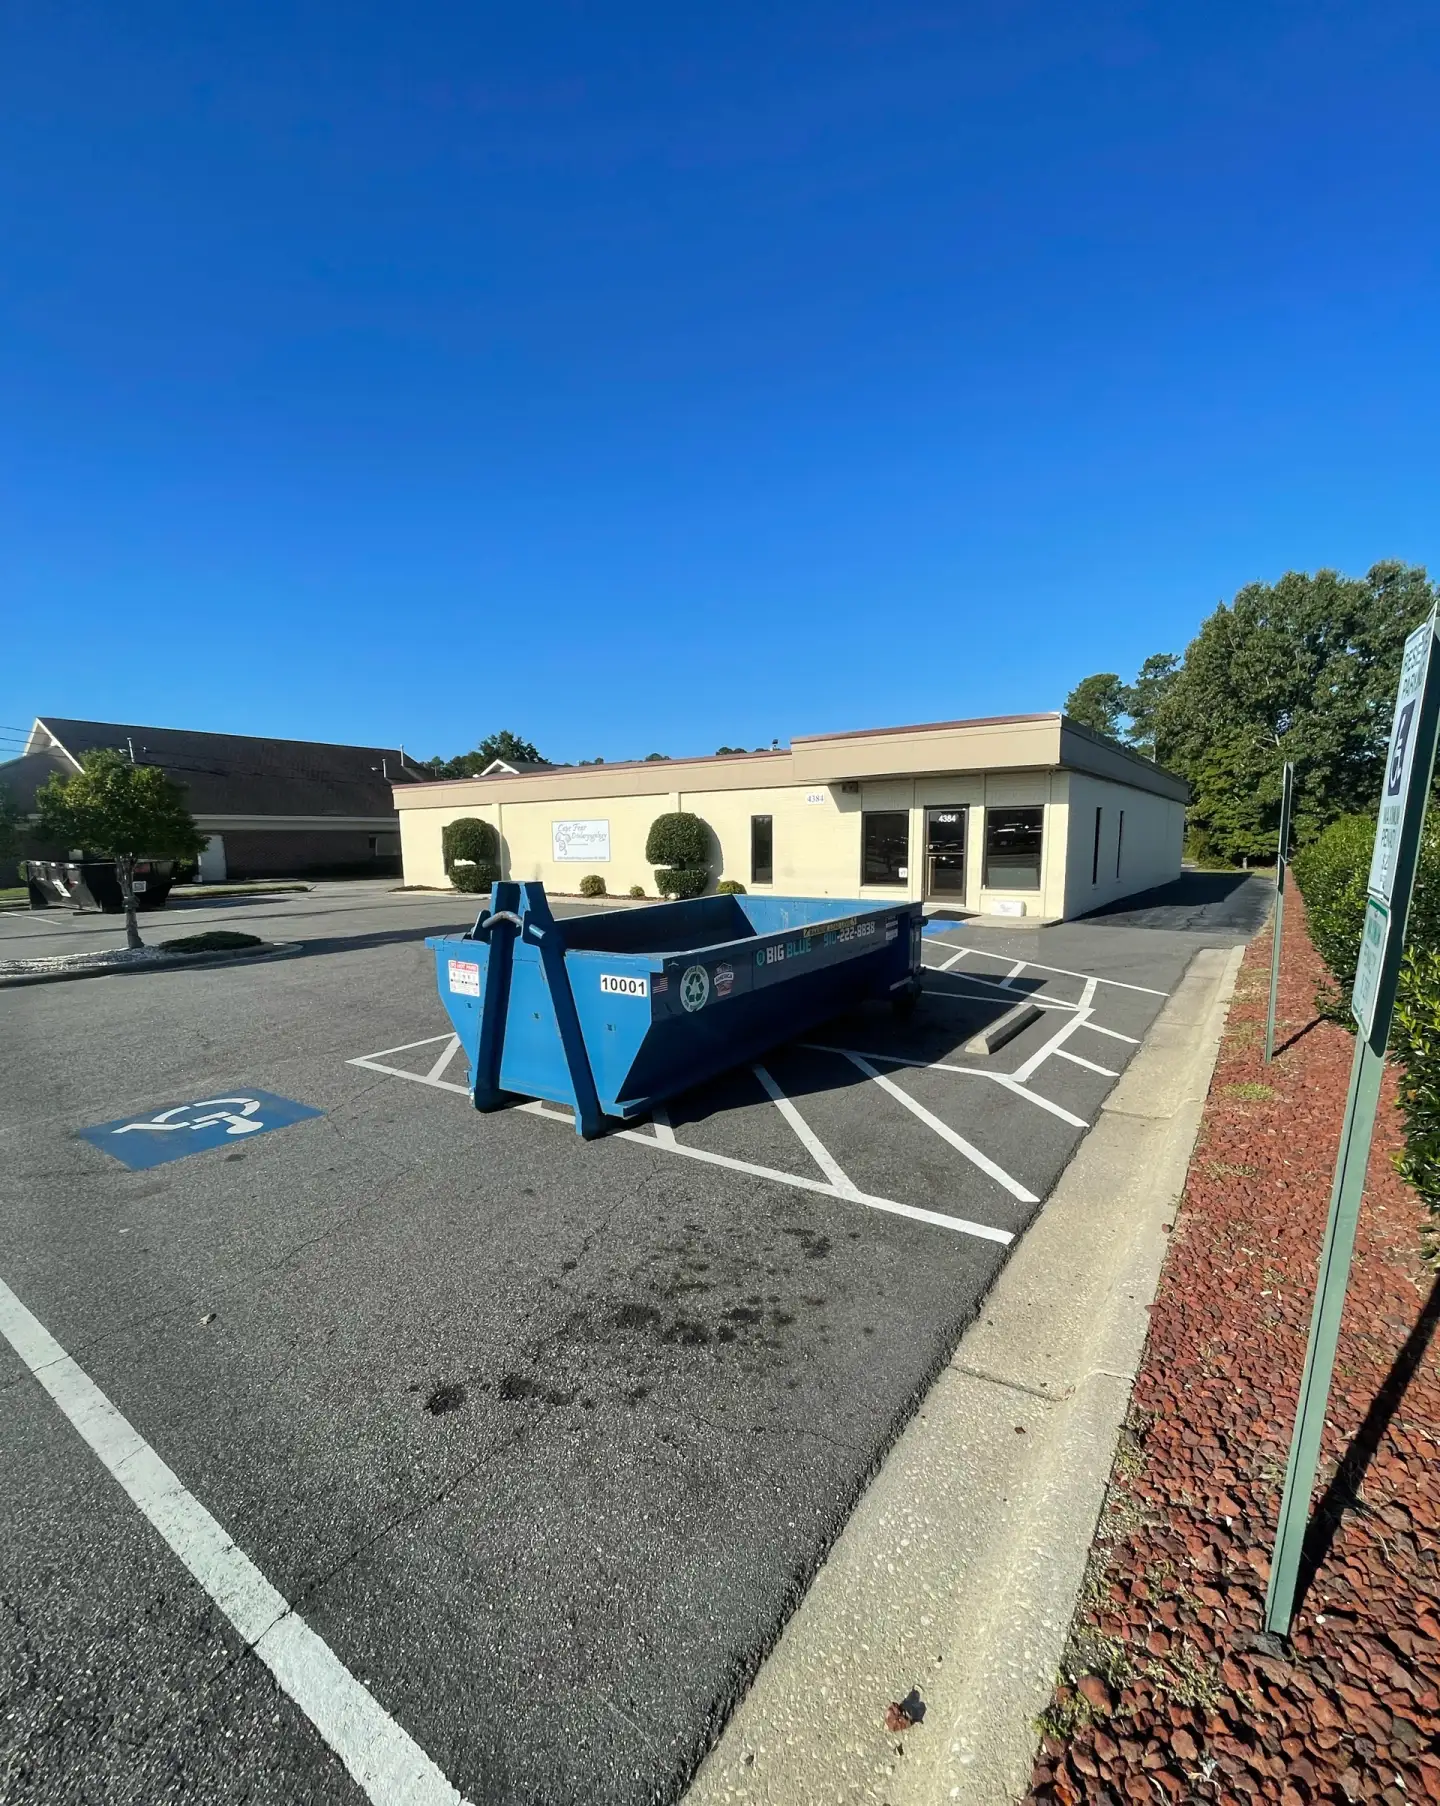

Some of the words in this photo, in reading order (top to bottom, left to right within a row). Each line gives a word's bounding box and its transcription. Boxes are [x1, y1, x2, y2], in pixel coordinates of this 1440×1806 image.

[807, 795, 824, 803] 4384
[938, 814, 956, 823] 4384
[558, 823, 572, 832] Cape
[573, 823, 588, 831] Fear
[766, 943, 785, 964] BIG
[786, 937, 812, 958] BLUE
[601, 977, 645, 995] 10001
